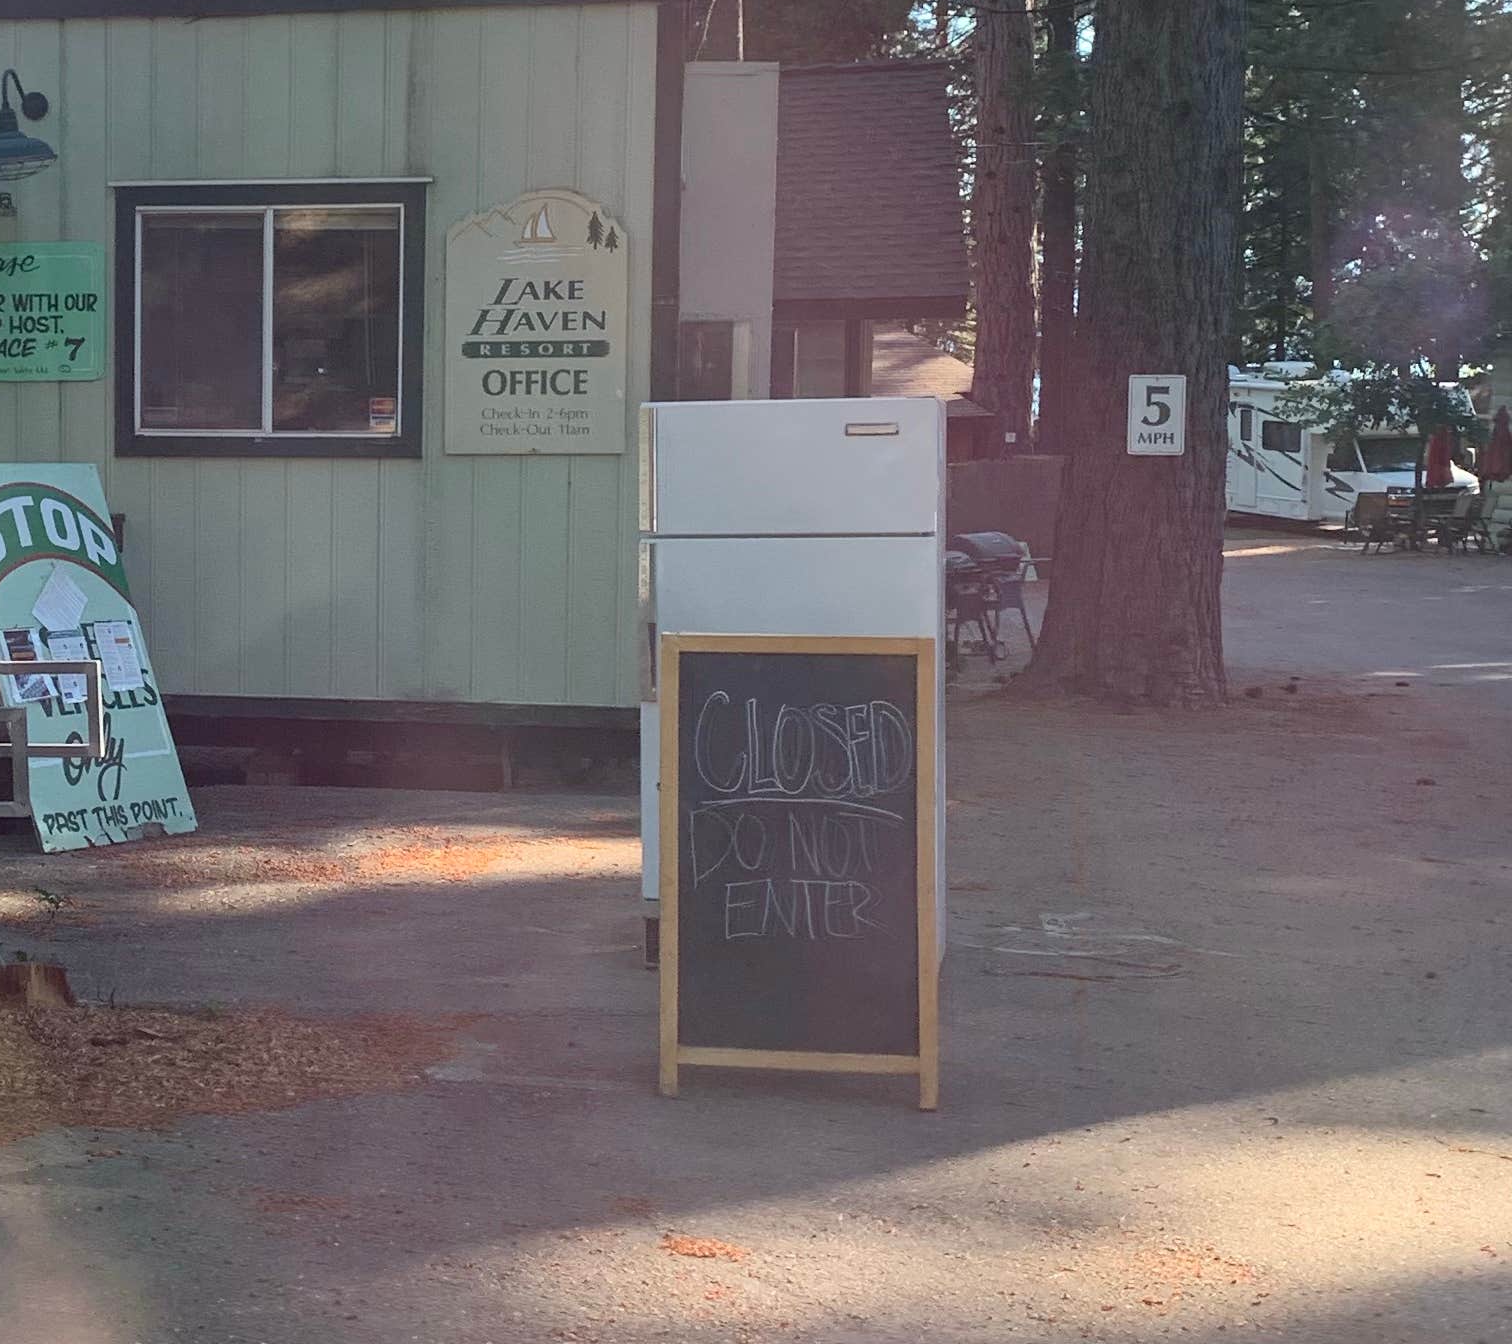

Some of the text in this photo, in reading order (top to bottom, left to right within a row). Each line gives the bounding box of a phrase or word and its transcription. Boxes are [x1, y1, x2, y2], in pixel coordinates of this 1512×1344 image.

[12, 294, 59, 313] WITH
[64, 293, 98, 312] OUR
[487, 277, 584, 306] LAKE
[9, 315, 65, 334] HOST.
[466, 308, 606, 336] HAVEN
[479, 343, 591, 356] RESORT
[482, 368, 588, 396] OFFICE
[1141, 385, 1171, 427] 5
[1137, 432, 1175, 445] MPH
[695, 690, 914, 799] CLOSED
[42, 797, 183, 836] PAST THIS POINT.
[690, 808, 903, 890] DO NOT
[724, 878, 900, 940] ENTER
